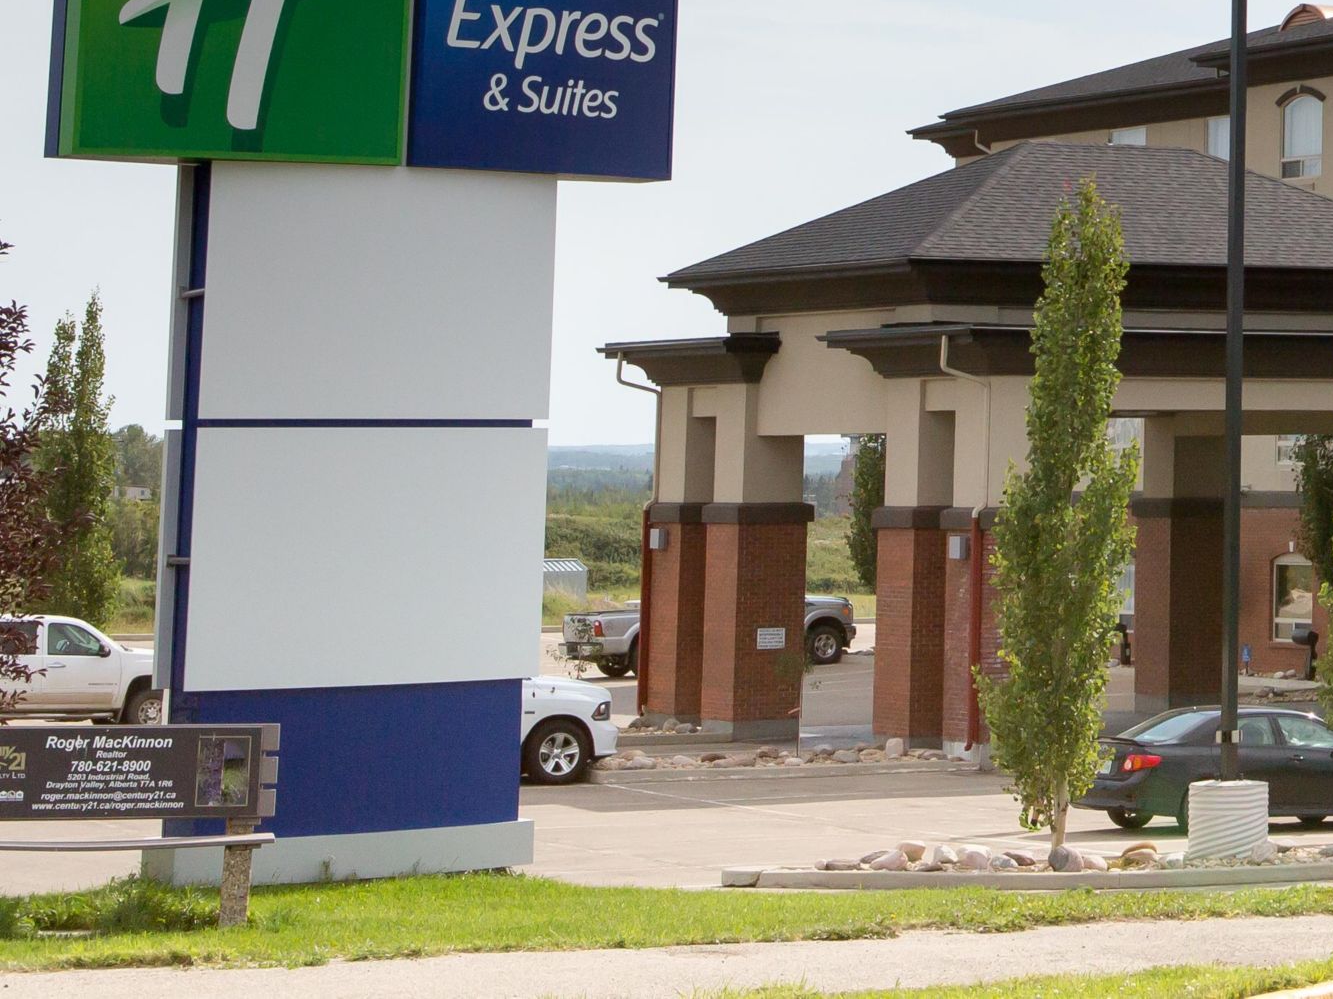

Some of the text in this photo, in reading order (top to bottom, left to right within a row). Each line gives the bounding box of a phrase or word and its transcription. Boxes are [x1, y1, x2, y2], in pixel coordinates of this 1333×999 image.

[483, 73, 620, 119] & Suites
[45, 735, 173, 752] Roger MacKinnon
[95, 750, 128, 759] Realtor
[71, 760, 152, 772] 780-621-8900
[67, 773, 86, 781] 5203
[87, 773, 126, 781] Industrial
[46, 781, 78, 790] Drayton
[108, 781, 138, 789] Alberta
